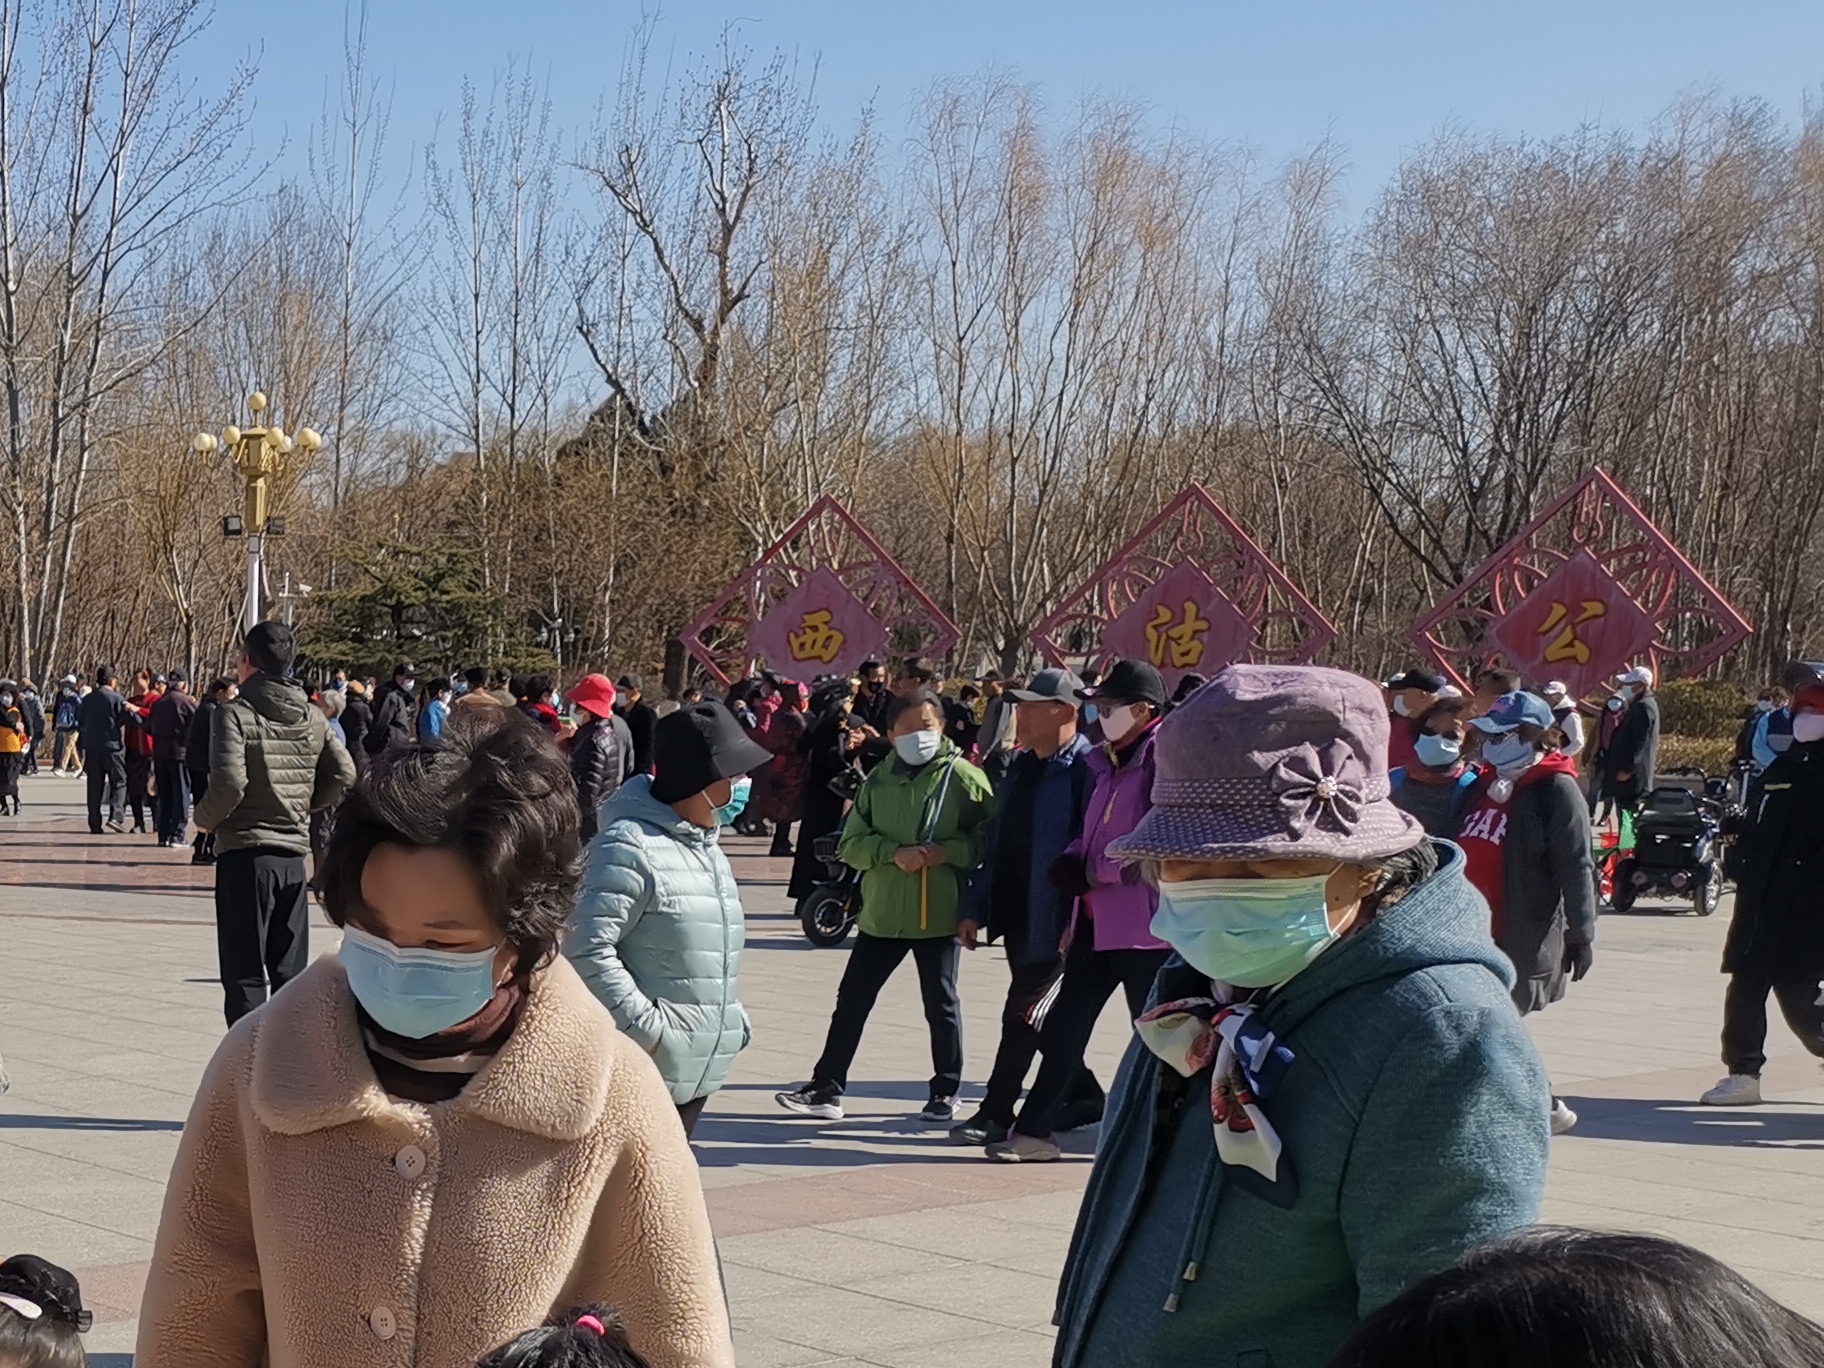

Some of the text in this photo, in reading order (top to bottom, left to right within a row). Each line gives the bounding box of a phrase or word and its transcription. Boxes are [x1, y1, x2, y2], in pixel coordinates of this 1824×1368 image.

[787, 599, 1607, 669] 西 沽 公
